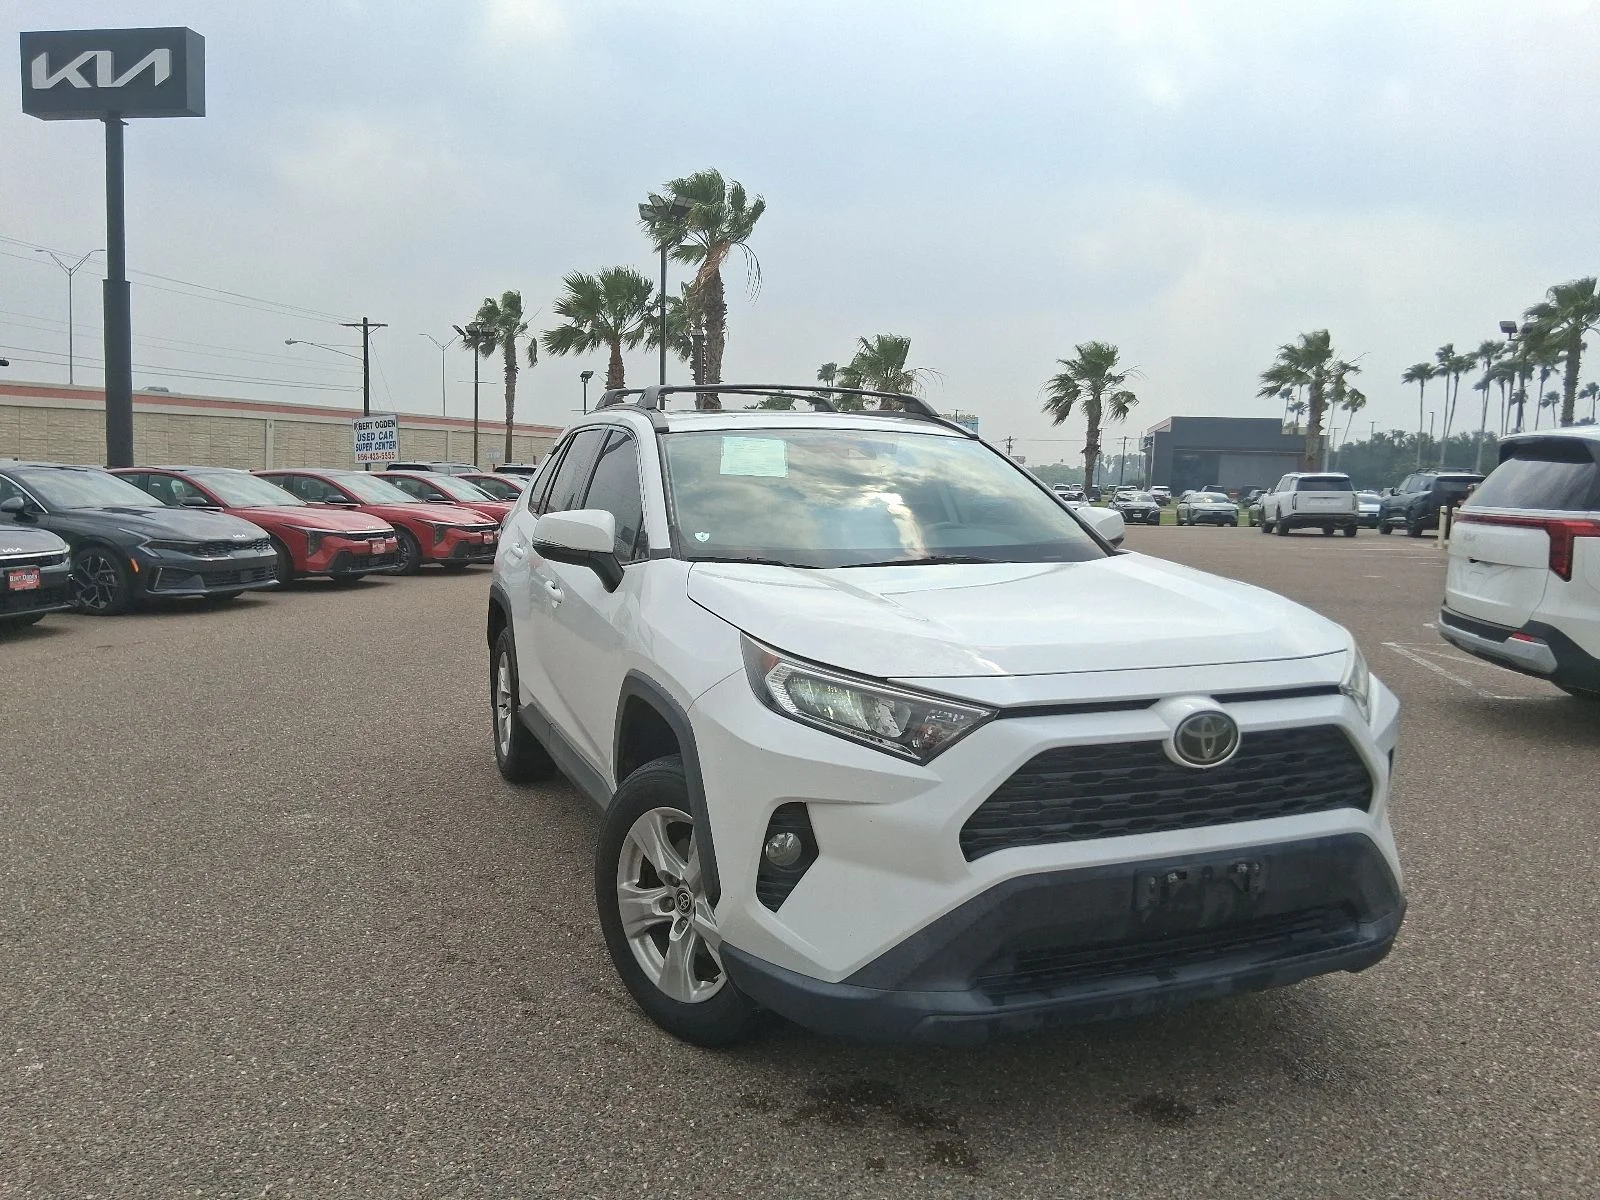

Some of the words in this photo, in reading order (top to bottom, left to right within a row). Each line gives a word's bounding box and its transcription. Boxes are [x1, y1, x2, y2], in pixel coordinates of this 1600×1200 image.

[32, 48, 172, 89] KIA
[375, 419, 396, 429] OGDEN
[357, 432, 376, 441] USED
[378, 430, 394, 440] CAR
[355, 442, 373, 452] SUPER
[374, 441, 397, 450] CENTER
